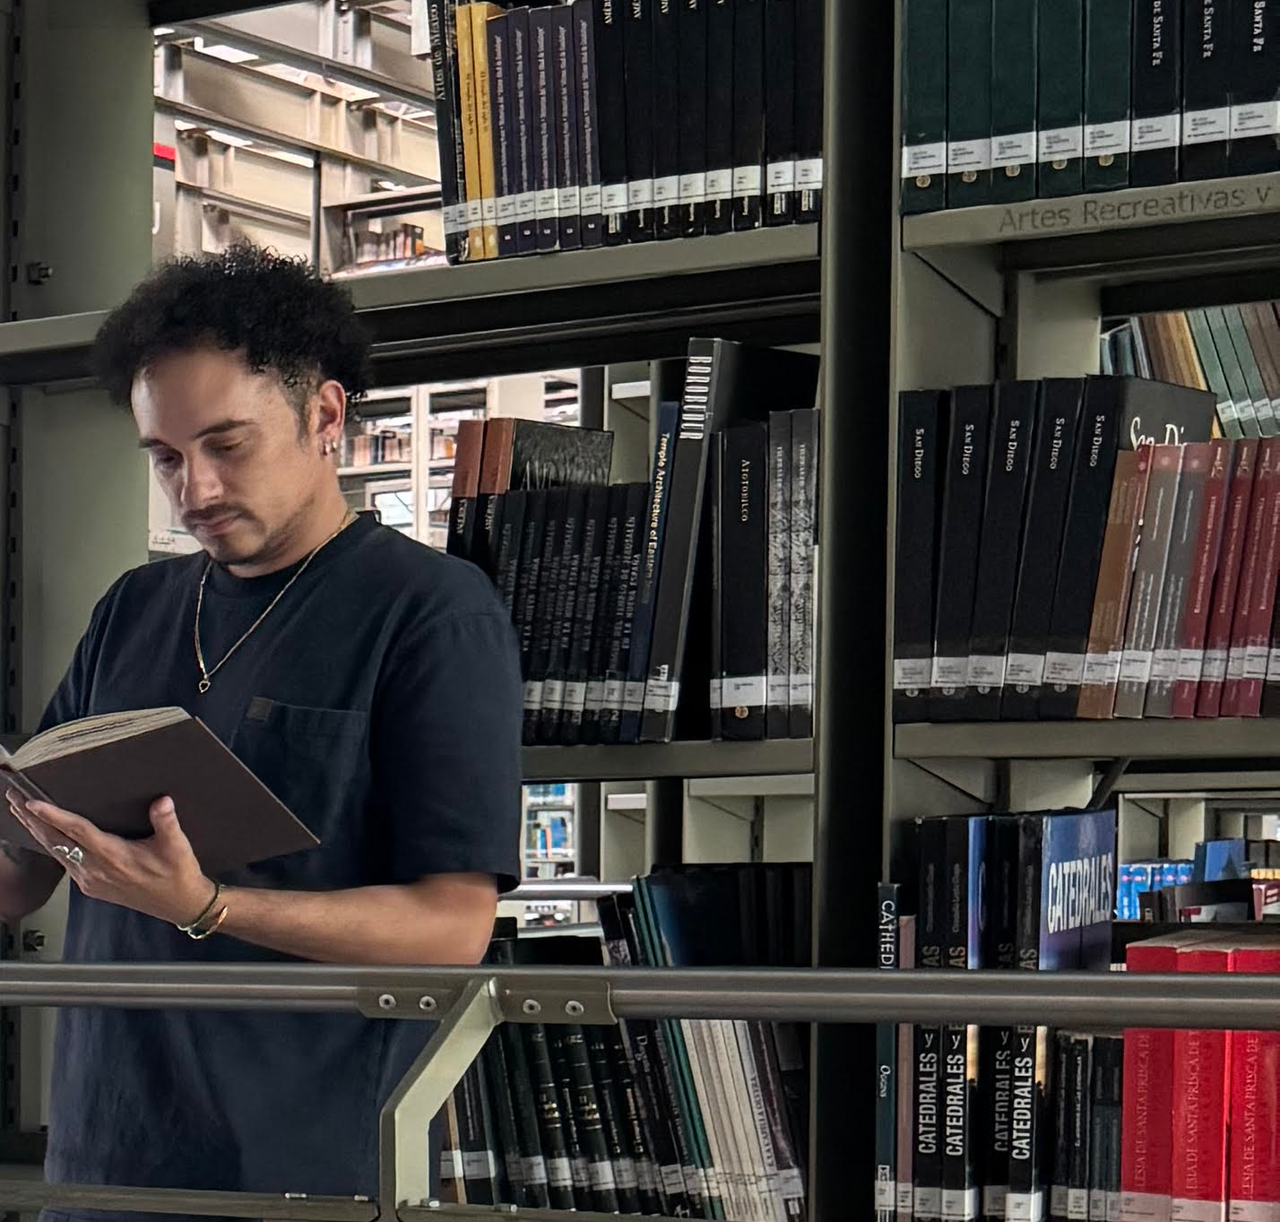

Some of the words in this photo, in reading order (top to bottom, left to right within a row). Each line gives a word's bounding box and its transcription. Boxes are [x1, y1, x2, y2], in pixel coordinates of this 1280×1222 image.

[999, 208, 1071, 233] Artes
[1083, 187, 1245, 224] Recreativas
[679, 356, 713, 439] BOROBUDUR
[656, 433, 670, 467] Temple
[650, 467, 666, 529] Architecture
[1047, 853, 1113, 934] CATEDRALES
[879, 900, 896, 970] CATHED
[952, 1035, 961, 1049] y
[1021, 1037, 1030, 1052] y
[1246, 1036, 1259, 1054] DE
[1185, 1057, 1200, 1101] PRISCA
[1245, 1054, 1258, 1099] PRISCA
[918, 1053, 937, 1154] CATEDRALES
[946, 1054, 964, 1156] CATEDRALES
[994, 1050, 1011, 1151] CATEDRALES
[1012, 1057, 1032, 1160] CATEDRALES
[1243, 1100, 1256, 1143] SANTA
[1186, 1103, 1199, 1144] SANTA
[1243, 1144, 1255, 1161] DE
